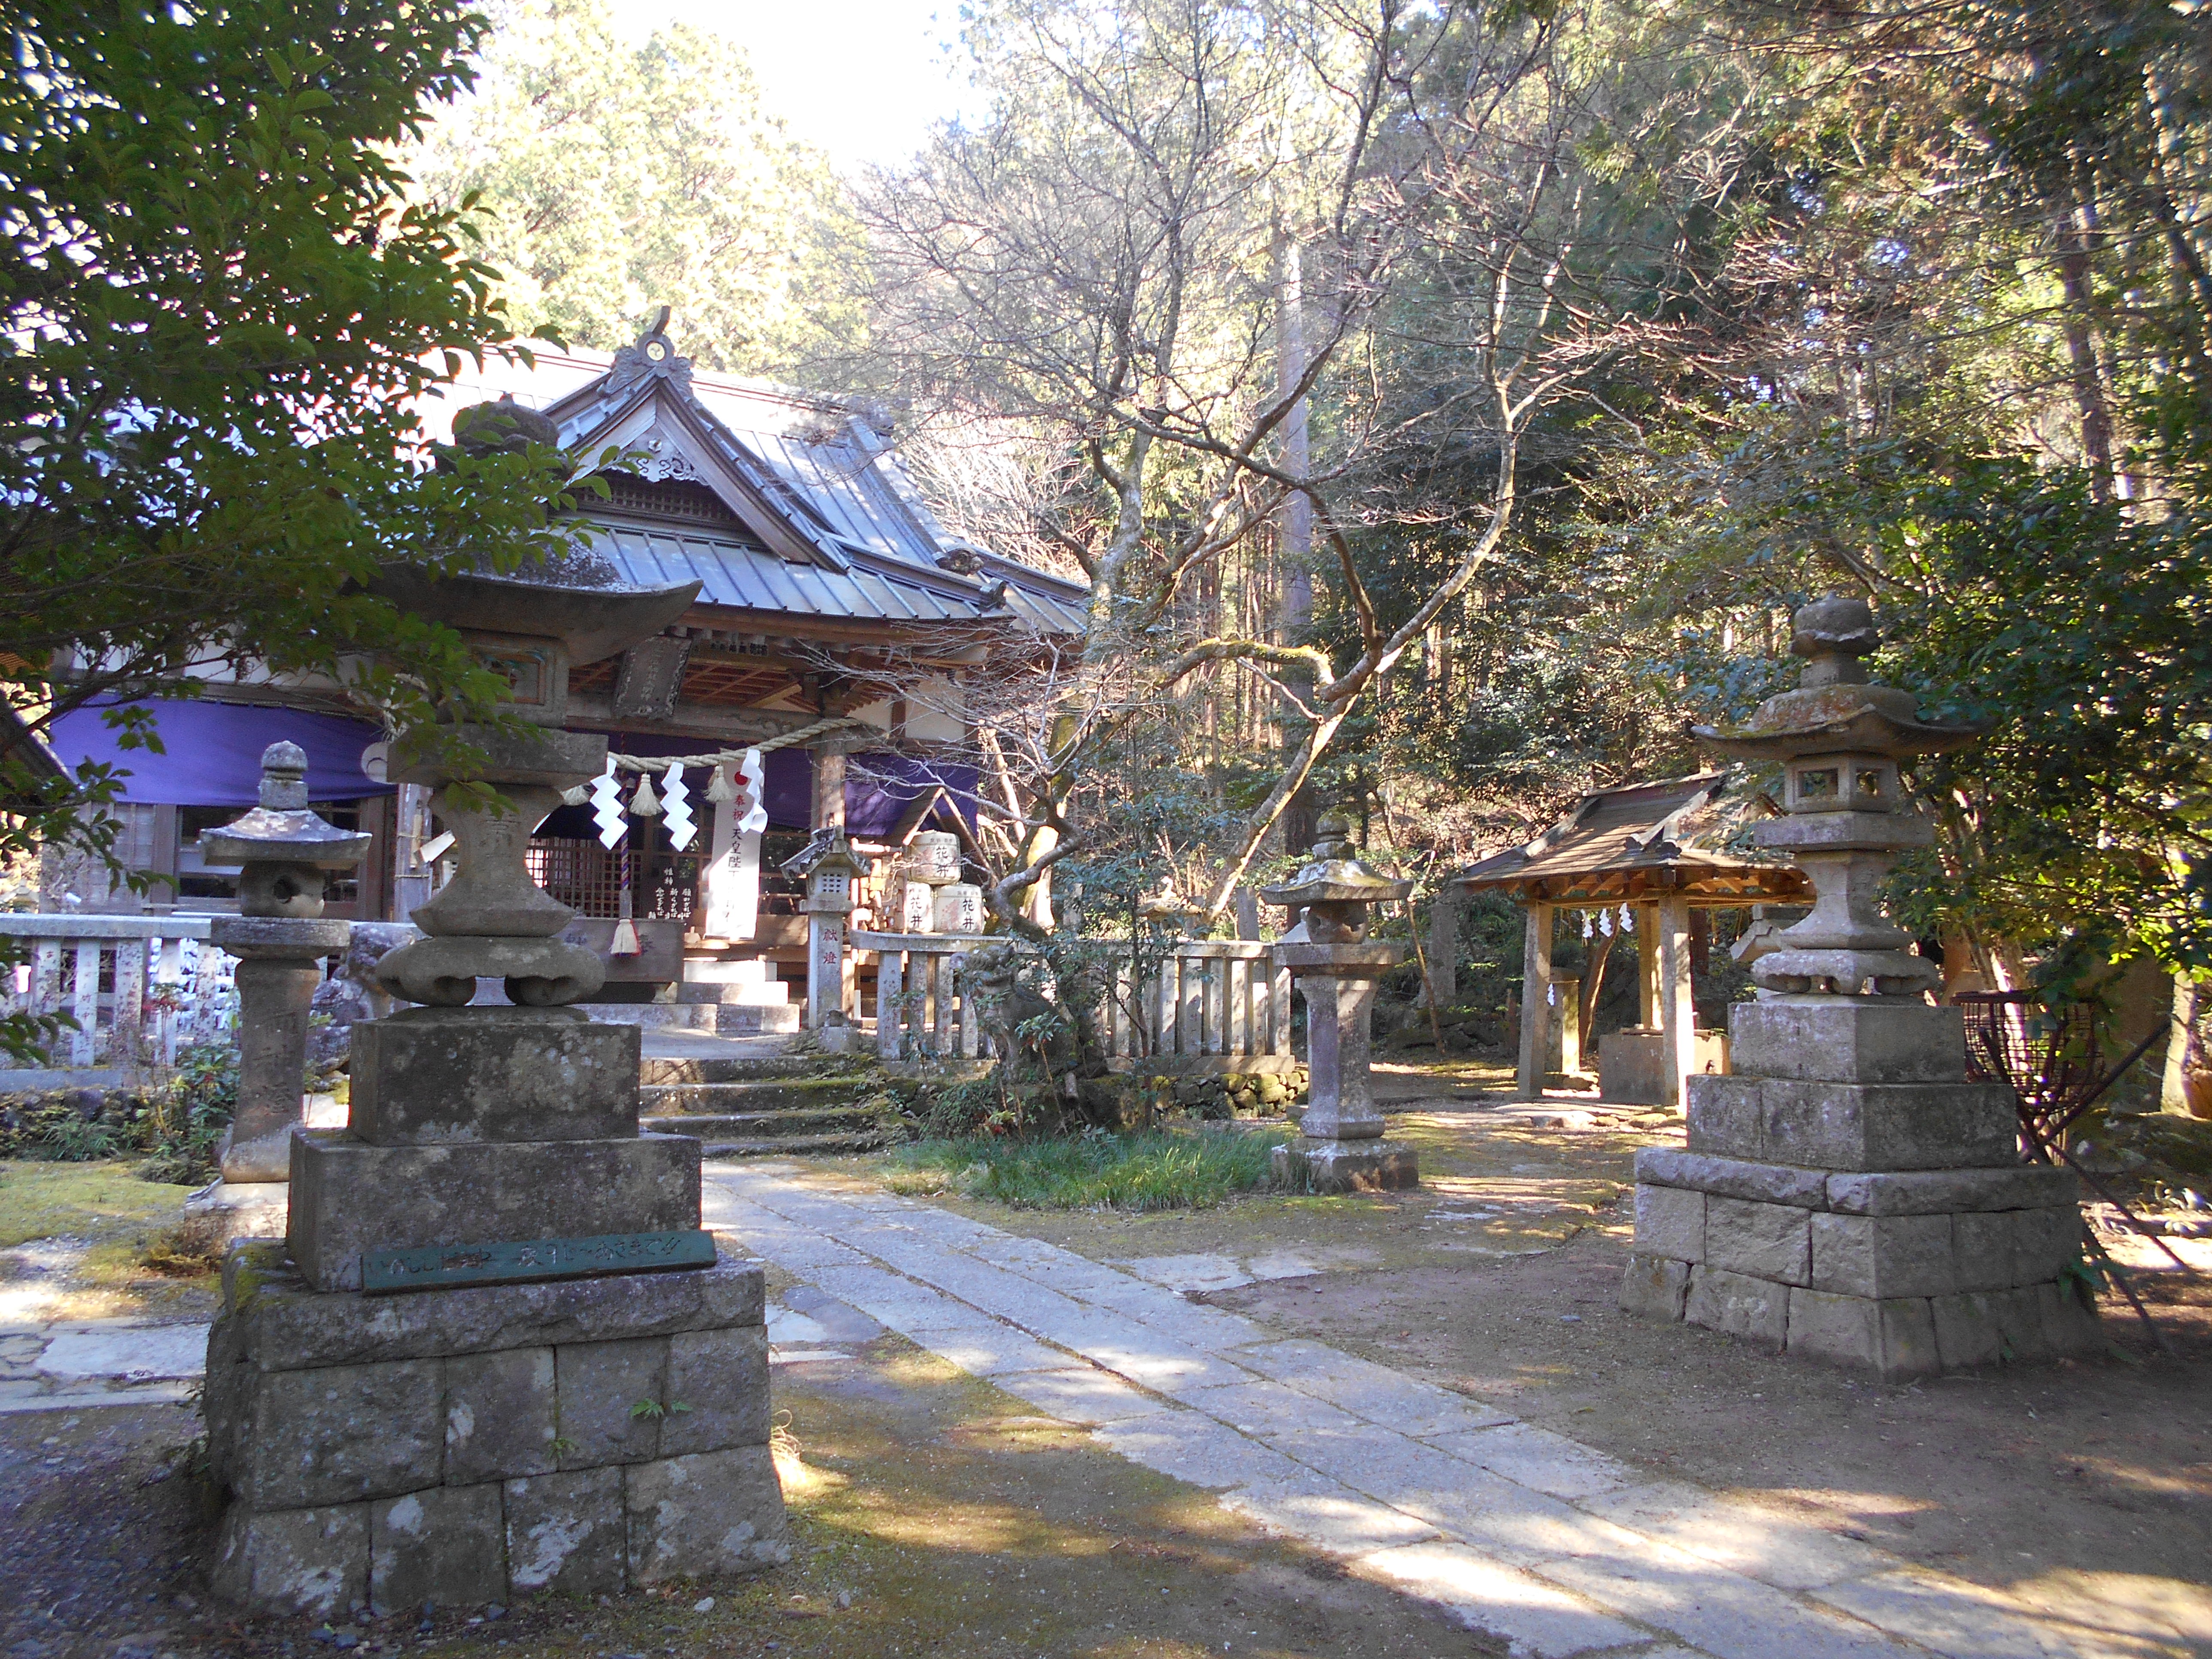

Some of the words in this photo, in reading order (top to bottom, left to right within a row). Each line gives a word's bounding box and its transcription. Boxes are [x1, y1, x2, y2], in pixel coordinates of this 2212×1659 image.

[936, 846, 949, 878] 花の井
[910, 896, 923, 928] 花の井
[962, 899, 975, 930] 花の井
